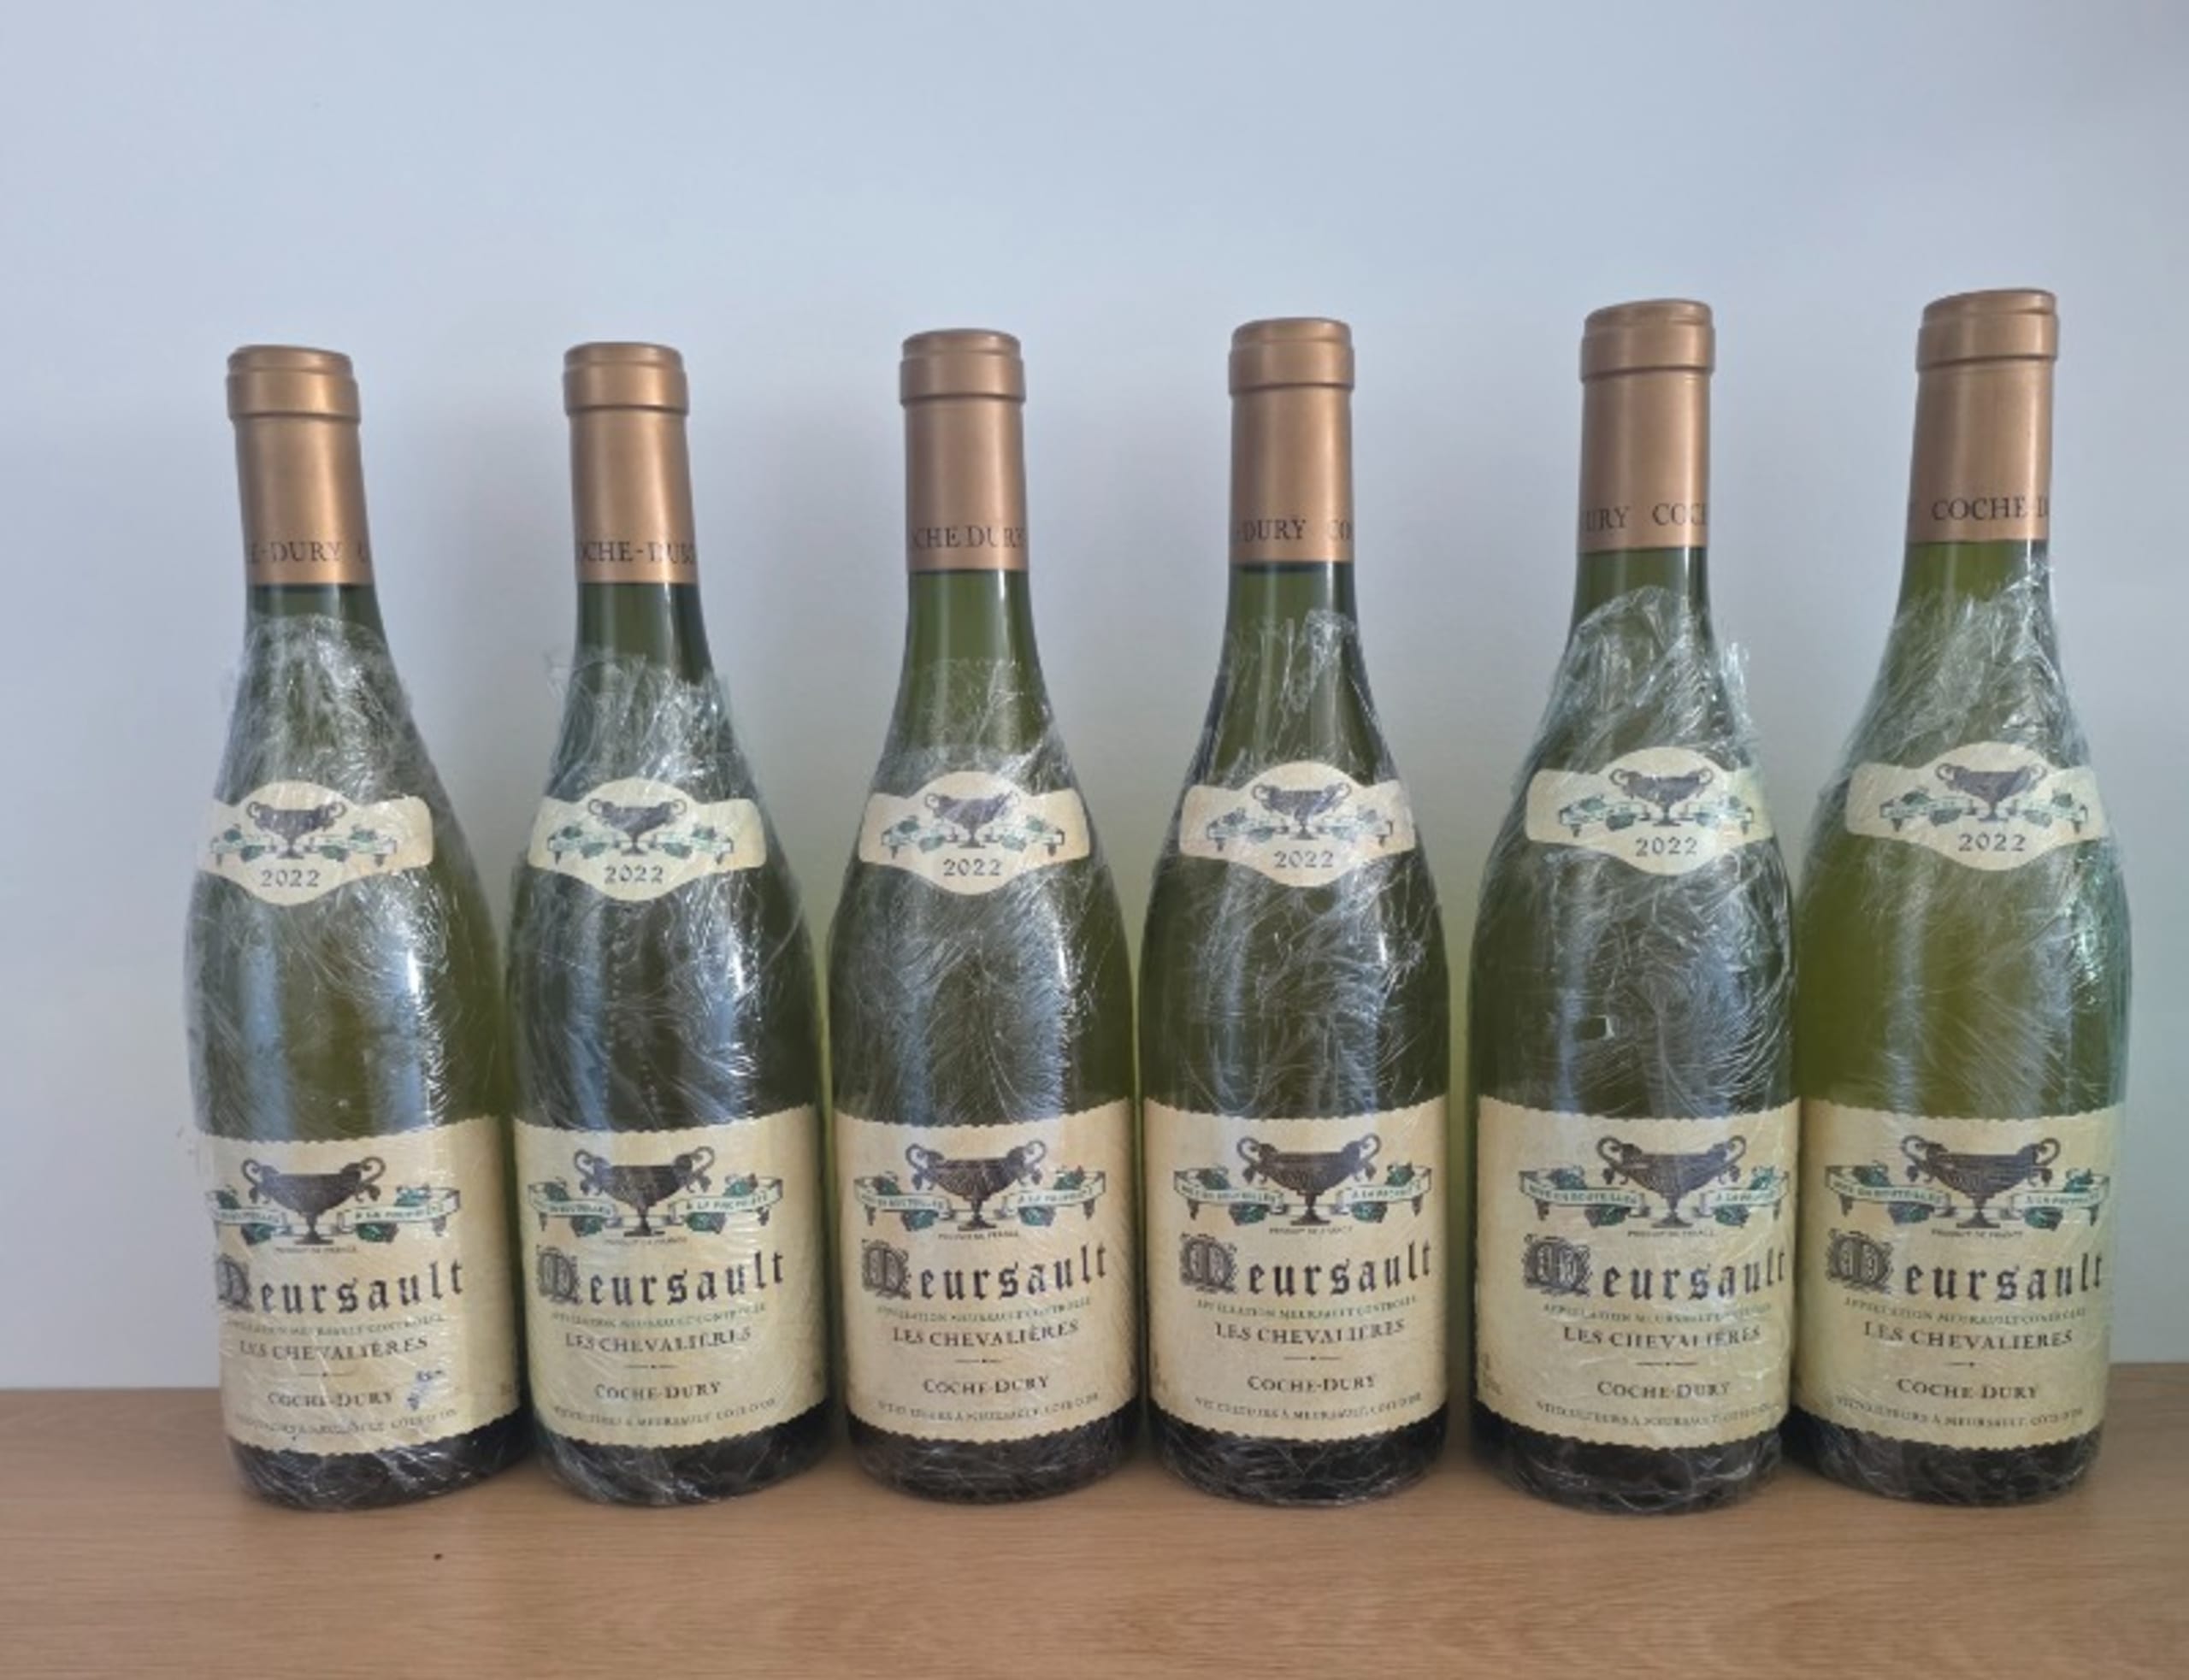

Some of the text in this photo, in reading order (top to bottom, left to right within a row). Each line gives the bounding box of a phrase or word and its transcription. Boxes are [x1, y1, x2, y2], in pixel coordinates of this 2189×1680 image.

[1635, 836, 1697, 858] 2022
[1959, 833, 2027, 852] 2022
[942, 858, 1001, 876] 2022
[1274, 851, 1333, 869] 2022
[260, 869, 320, 887] 2022
[604, 864, 664, 884] 2022
[861, 1238, 1106, 1300] Meursault
[1179, 1232, 1430, 1297] Meursault
[1826, 1228, 2103, 1301] Meursault
[891, 1326, 923, 1344] LES
[1214, 1320, 1251, 1341] LES
[1564, 1326, 1602, 1344] LES
[1864, 1320, 1903, 1341] LES
[239, 1339, 267, 1358] LES
[565, 1333, 594, 1350] LES
